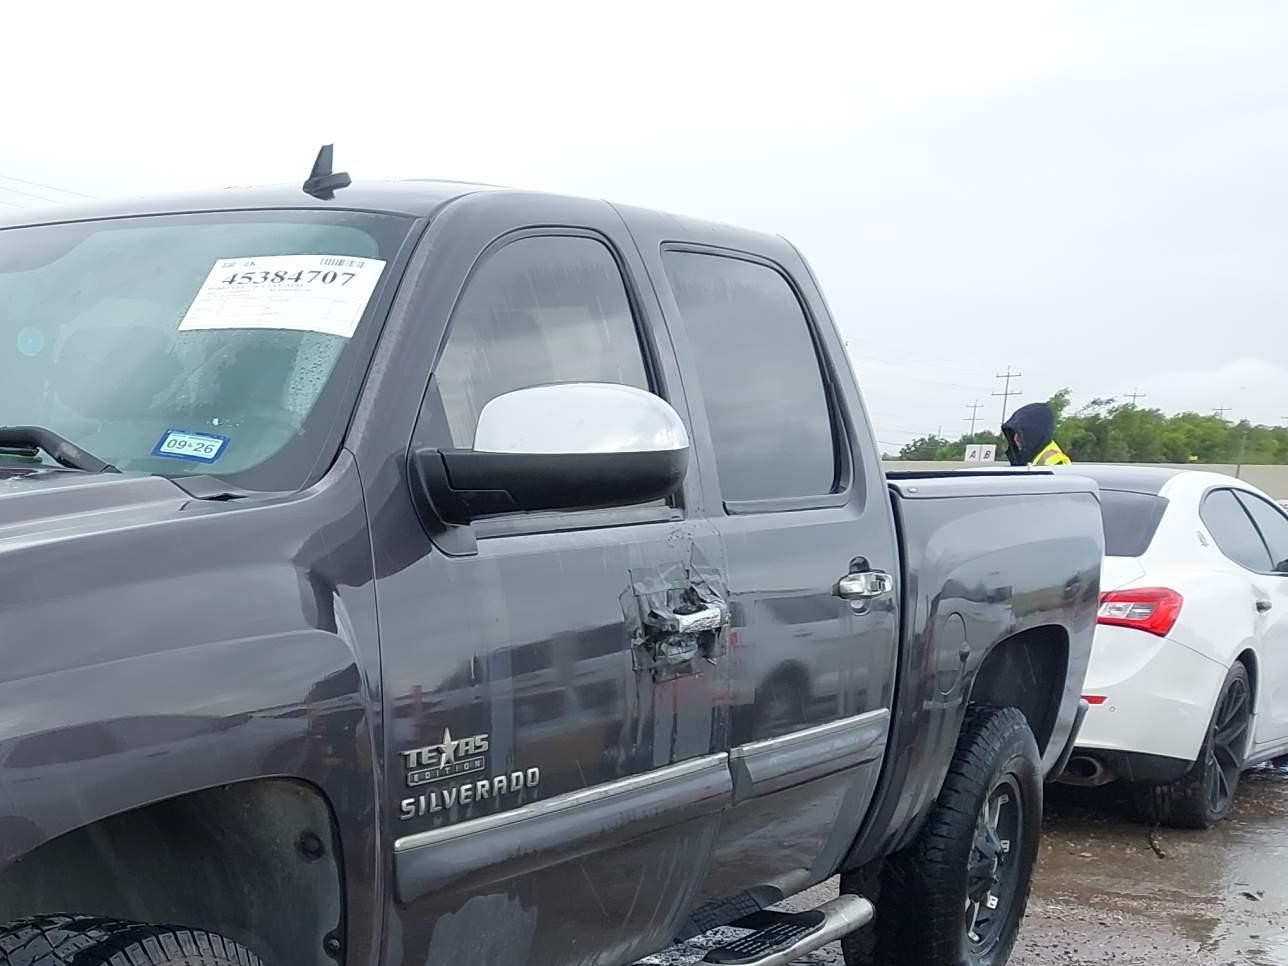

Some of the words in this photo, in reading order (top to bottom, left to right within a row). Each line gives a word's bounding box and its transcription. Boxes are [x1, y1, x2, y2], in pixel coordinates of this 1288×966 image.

[222, 270, 356, 286] 45384707
[166, 438, 187, 450] 09
[193, 442, 216, 454] 26
[969, 450, 977, 459] A
[983, 450, 992, 459] B
[399, 727, 489, 770] TEXAS
[412, 760, 482, 782] EDITION
[399, 766, 540, 820] SILVERADO
